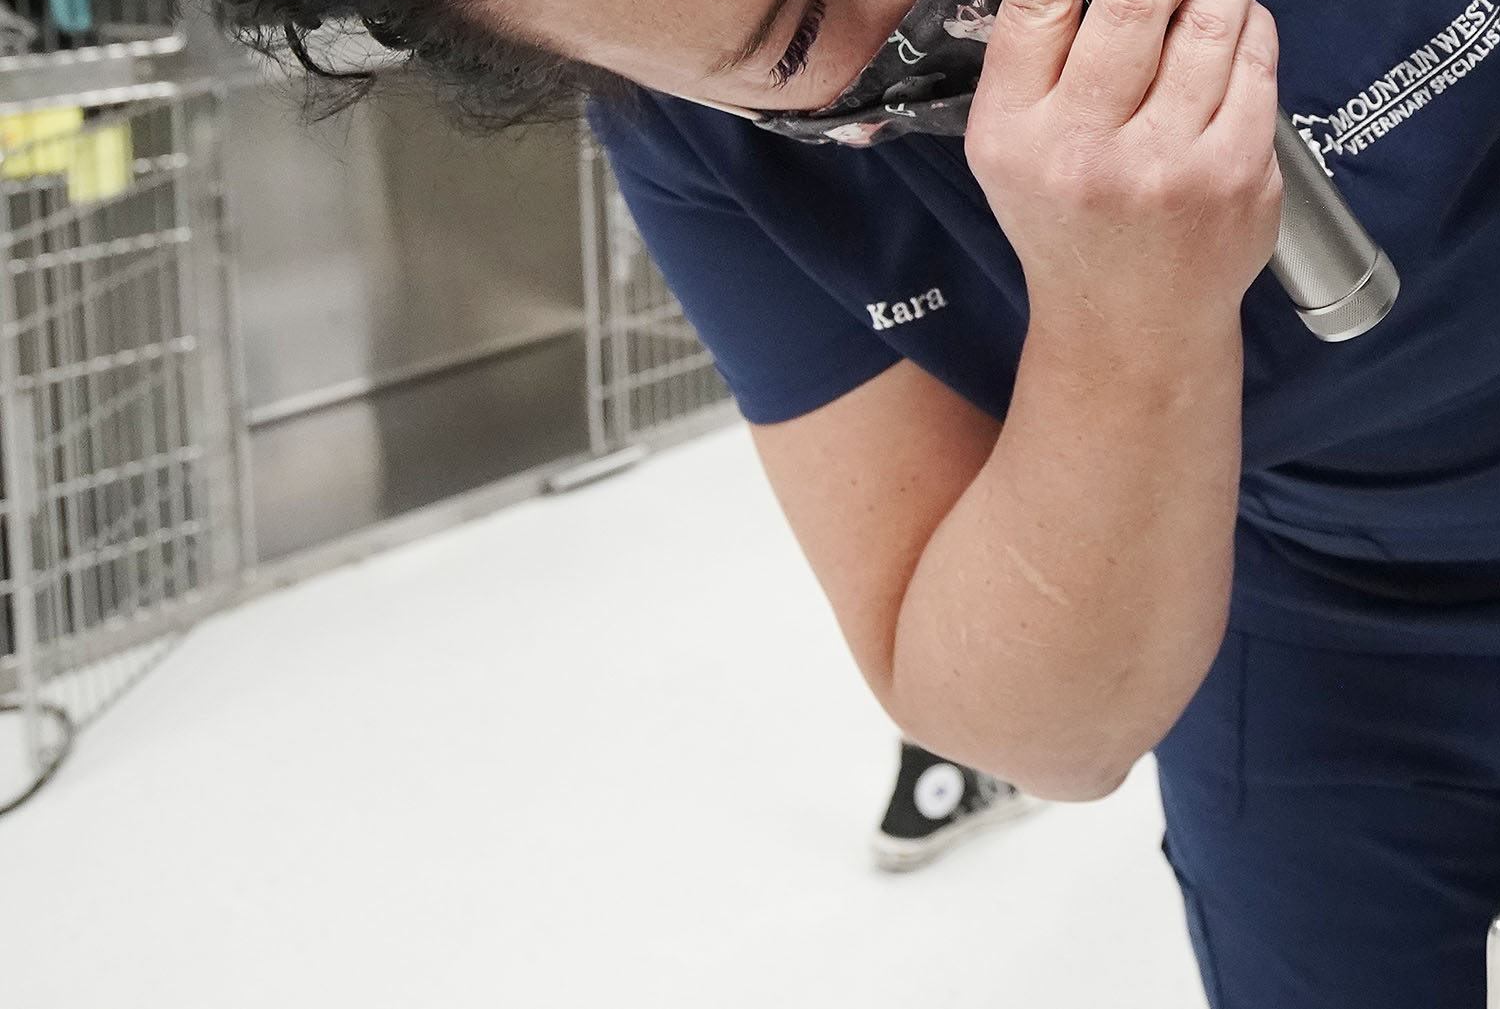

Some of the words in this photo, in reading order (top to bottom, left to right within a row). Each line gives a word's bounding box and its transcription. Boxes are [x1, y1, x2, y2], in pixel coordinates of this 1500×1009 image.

[1328, 44, 1440, 137] MOUNTAIN
[1343, 86, 1433, 156] VETERINARY
[866, 288, 948, 330] Kara
